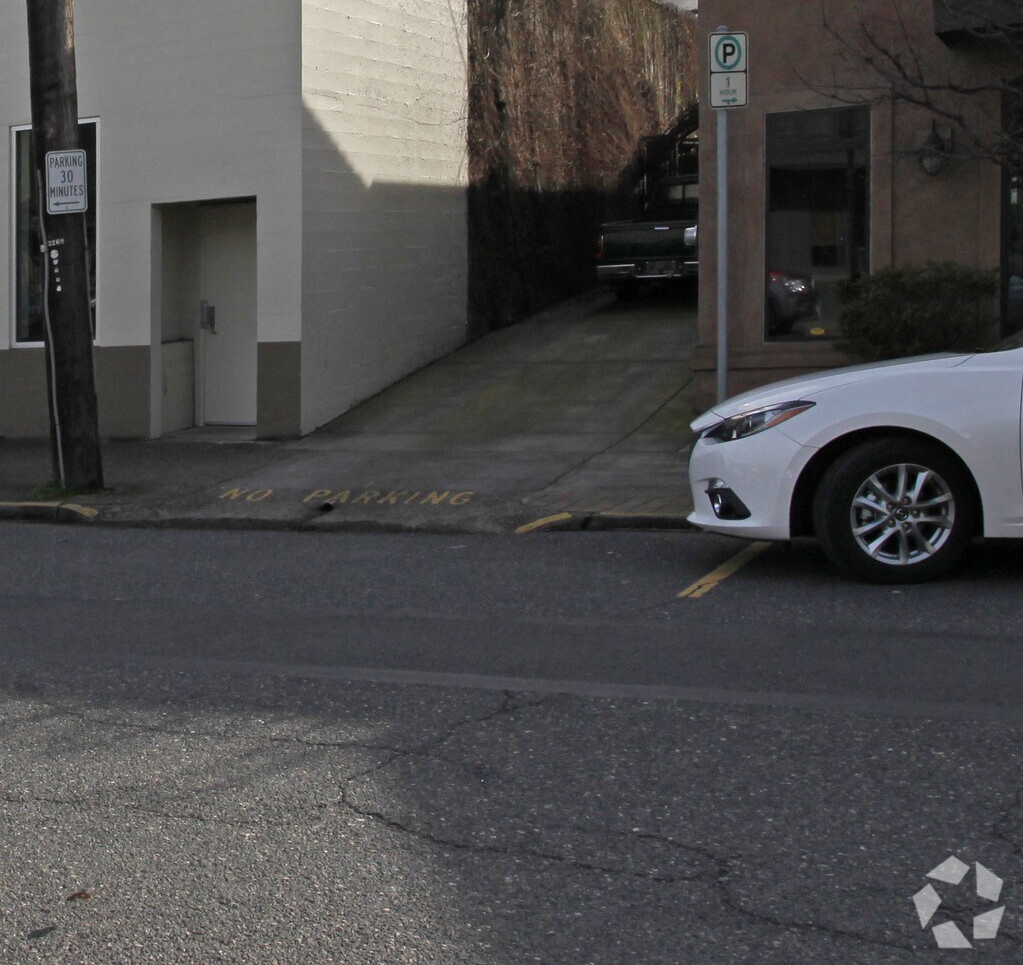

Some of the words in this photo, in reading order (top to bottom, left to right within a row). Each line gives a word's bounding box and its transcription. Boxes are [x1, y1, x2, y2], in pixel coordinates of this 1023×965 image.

[722, 43, 736, 64] P
[725, 76, 730, 88] 1
[49, 155, 83, 168] PARKING
[60, 169, 74, 183] 30
[49, 184, 84, 198] MINUTES
[218, 488, 273, 501] NO
[303, 489, 475, 505] PARKING
